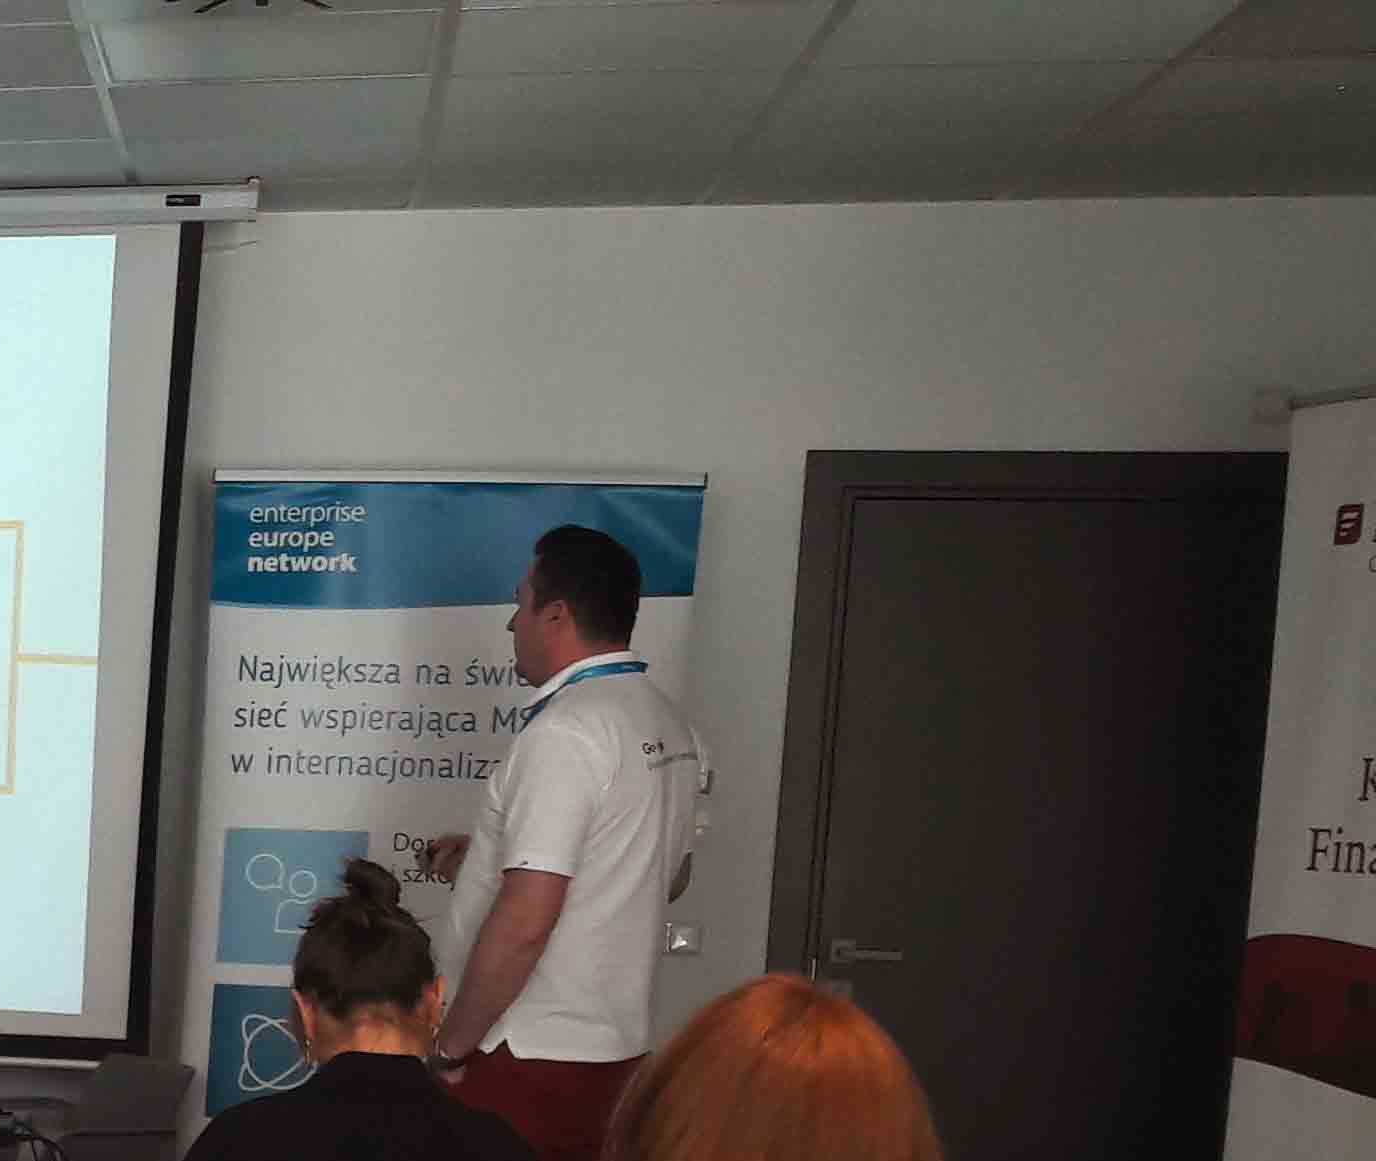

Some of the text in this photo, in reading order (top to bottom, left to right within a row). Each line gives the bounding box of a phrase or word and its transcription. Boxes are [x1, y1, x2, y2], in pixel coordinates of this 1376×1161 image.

[249, 501, 366, 527] enterprise
[248, 530, 335, 552] europe
[248, 553, 358, 573] network
[237, 655, 401, 689] Największa
[415, 663, 452, 685] na
[233, 701, 288, 728] sieć
[300, 702, 477, 738] wspierająca
[231, 747, 500, 784] w internacjonaliz
